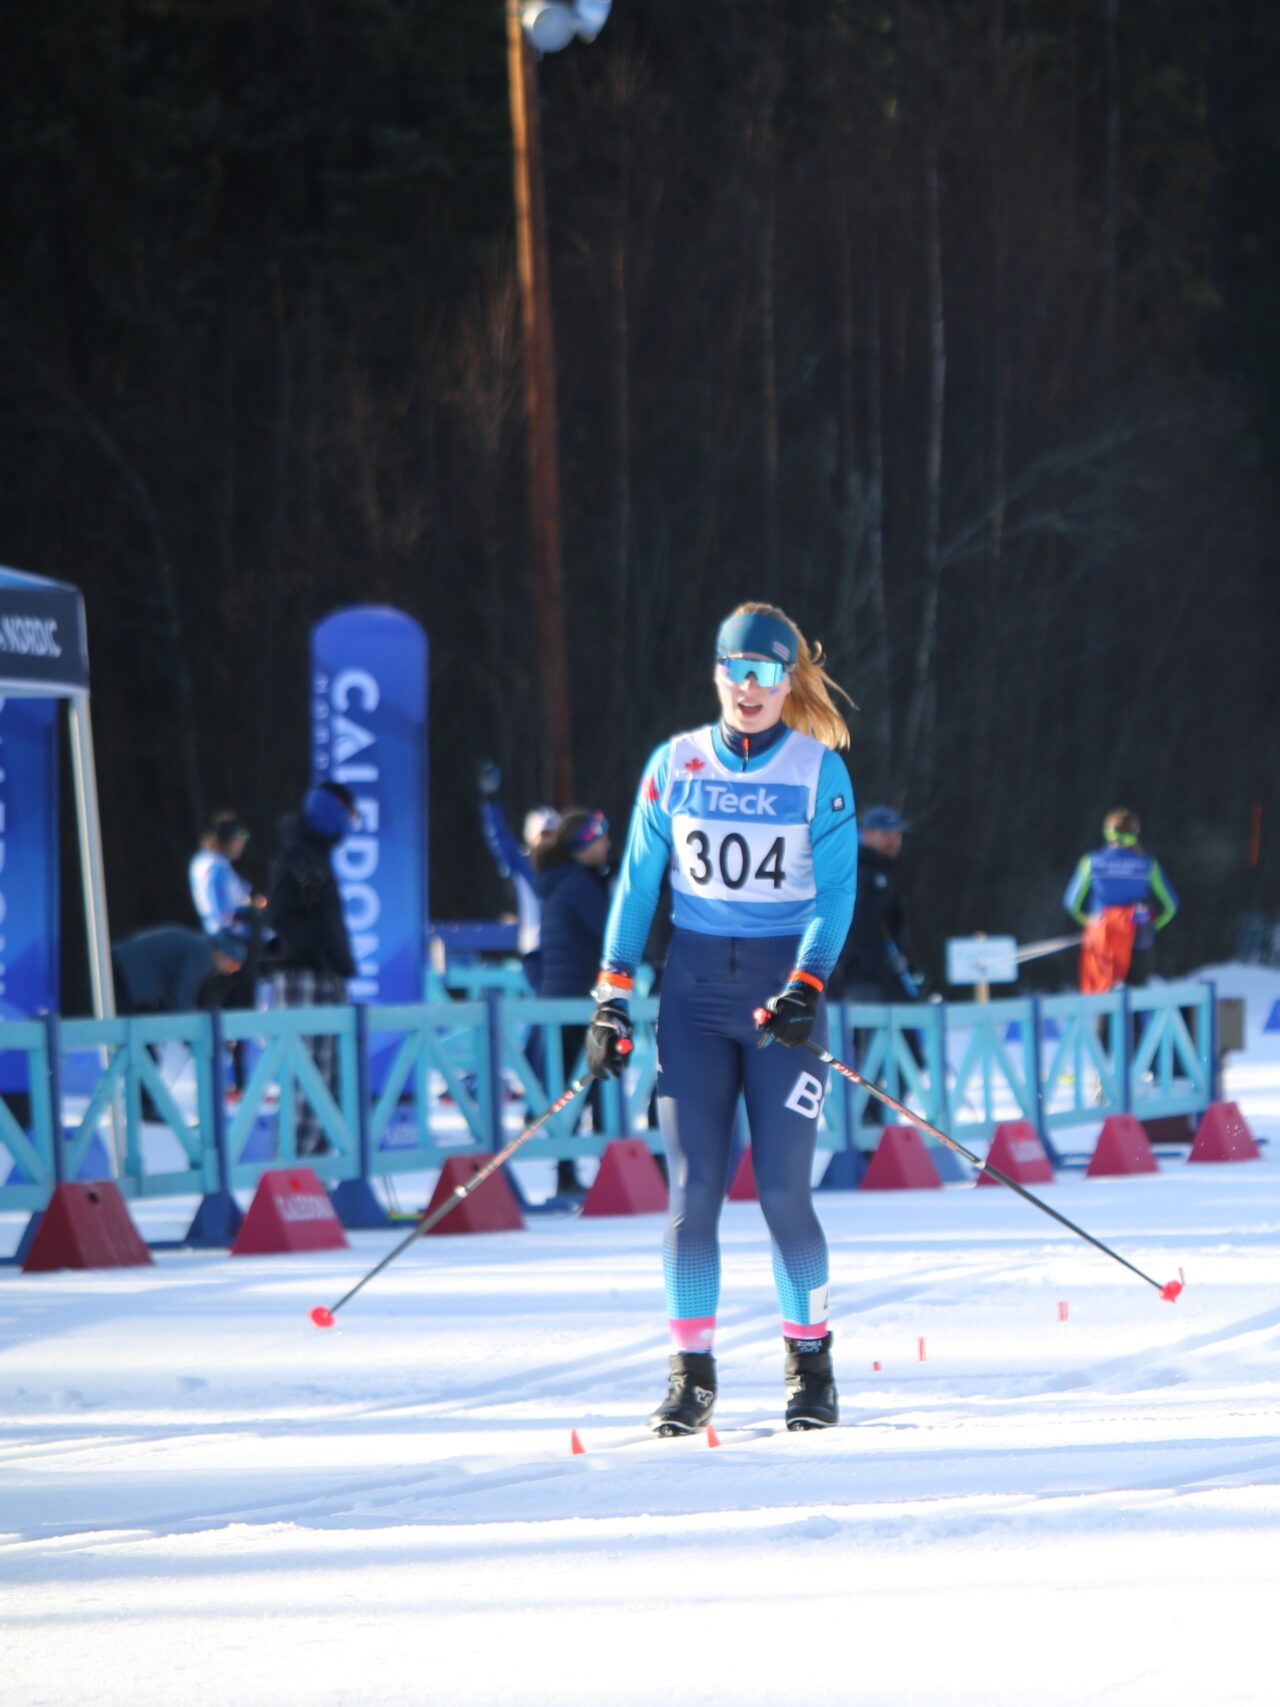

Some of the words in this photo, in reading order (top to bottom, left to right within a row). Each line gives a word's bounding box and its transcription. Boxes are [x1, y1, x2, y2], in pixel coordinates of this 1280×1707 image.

[3, 616, 62, 658] NORDIC
[704, 785, 778, 816] Teck
[331, 668, 381, 997] CALEDONI
[686, 830, 786, 890] 304
[785, 1070, 825, 1120] B
